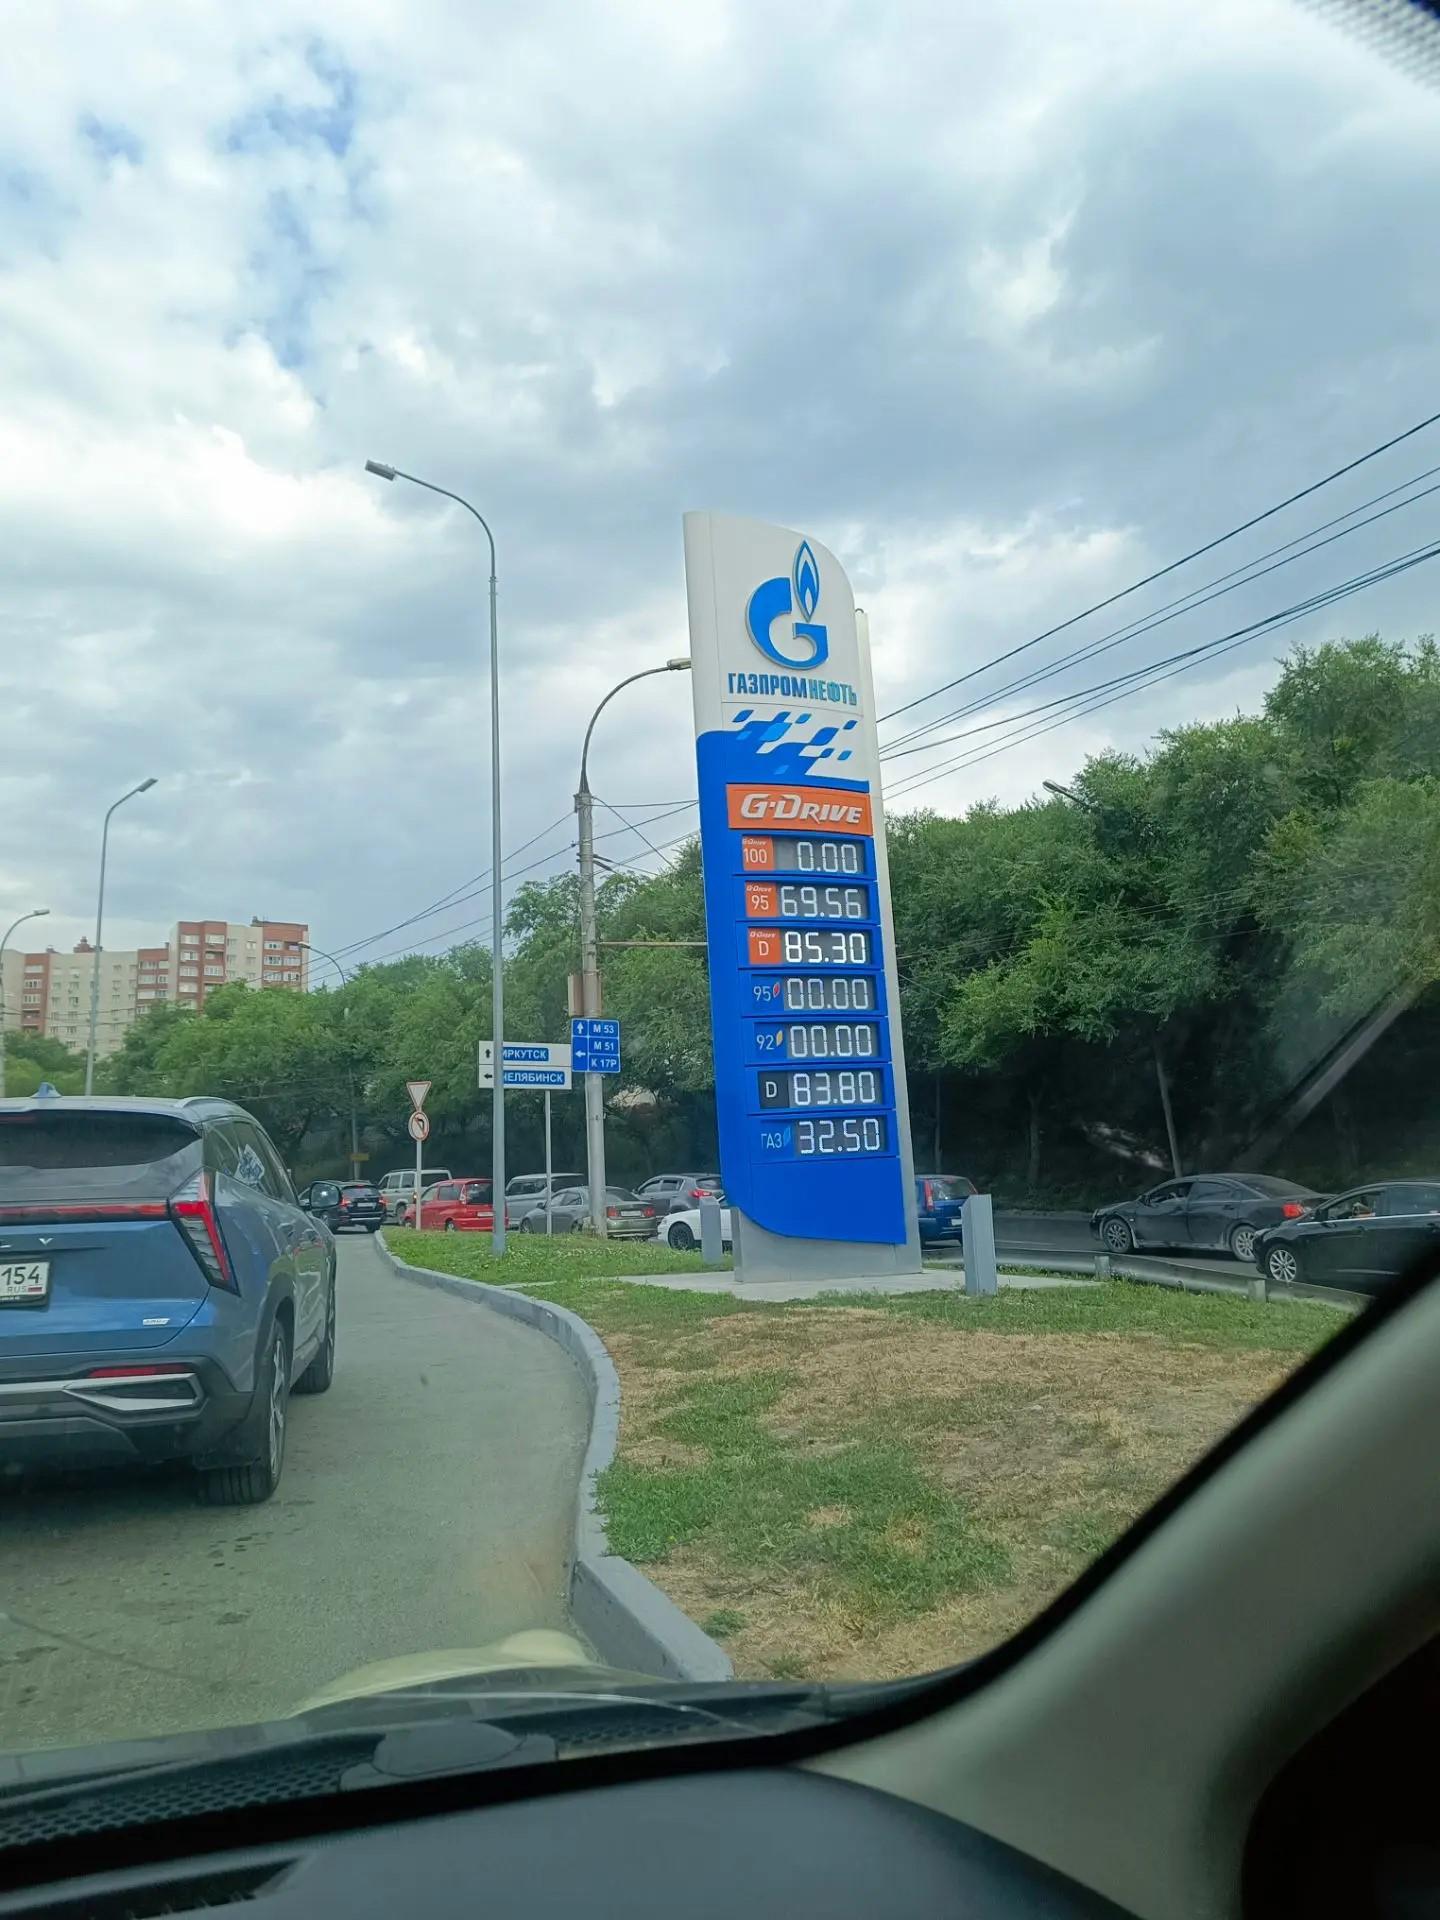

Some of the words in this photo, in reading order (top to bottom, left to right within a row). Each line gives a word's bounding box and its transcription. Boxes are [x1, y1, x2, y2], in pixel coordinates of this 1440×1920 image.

[728, 673, 857, 705] ГАЗПРОМНЕФТЬ
[744, 848, 767, 863] 100
[798, 842, 858, 873] 0.00
[752, 895, 768, 910] 95
[781, 886, 861, 918] 69.56
[759, 941, 769, 956] D
[785, 931, 866, 963] 85.30
[753, 986, 772, 1002] 95
[787, 978, 868, 1009] 00.00
[604, 1025, 614, 1034] 53
[757, 1035, 775, 1051] 92
[790, 1025, 872, 1057] 00.00
[605, 1042, 614, 1051] 51
[600, 1059, 617, 1069] 17Р
[766, 1081, 777, 1098] D
[793, 1072, 876, 1106] 83.80
[761, 1133, 782, 1149] ГАЗ
[799, 1118, 880, 1153] 32.50
[1, 1265, 40, 1286] 154
